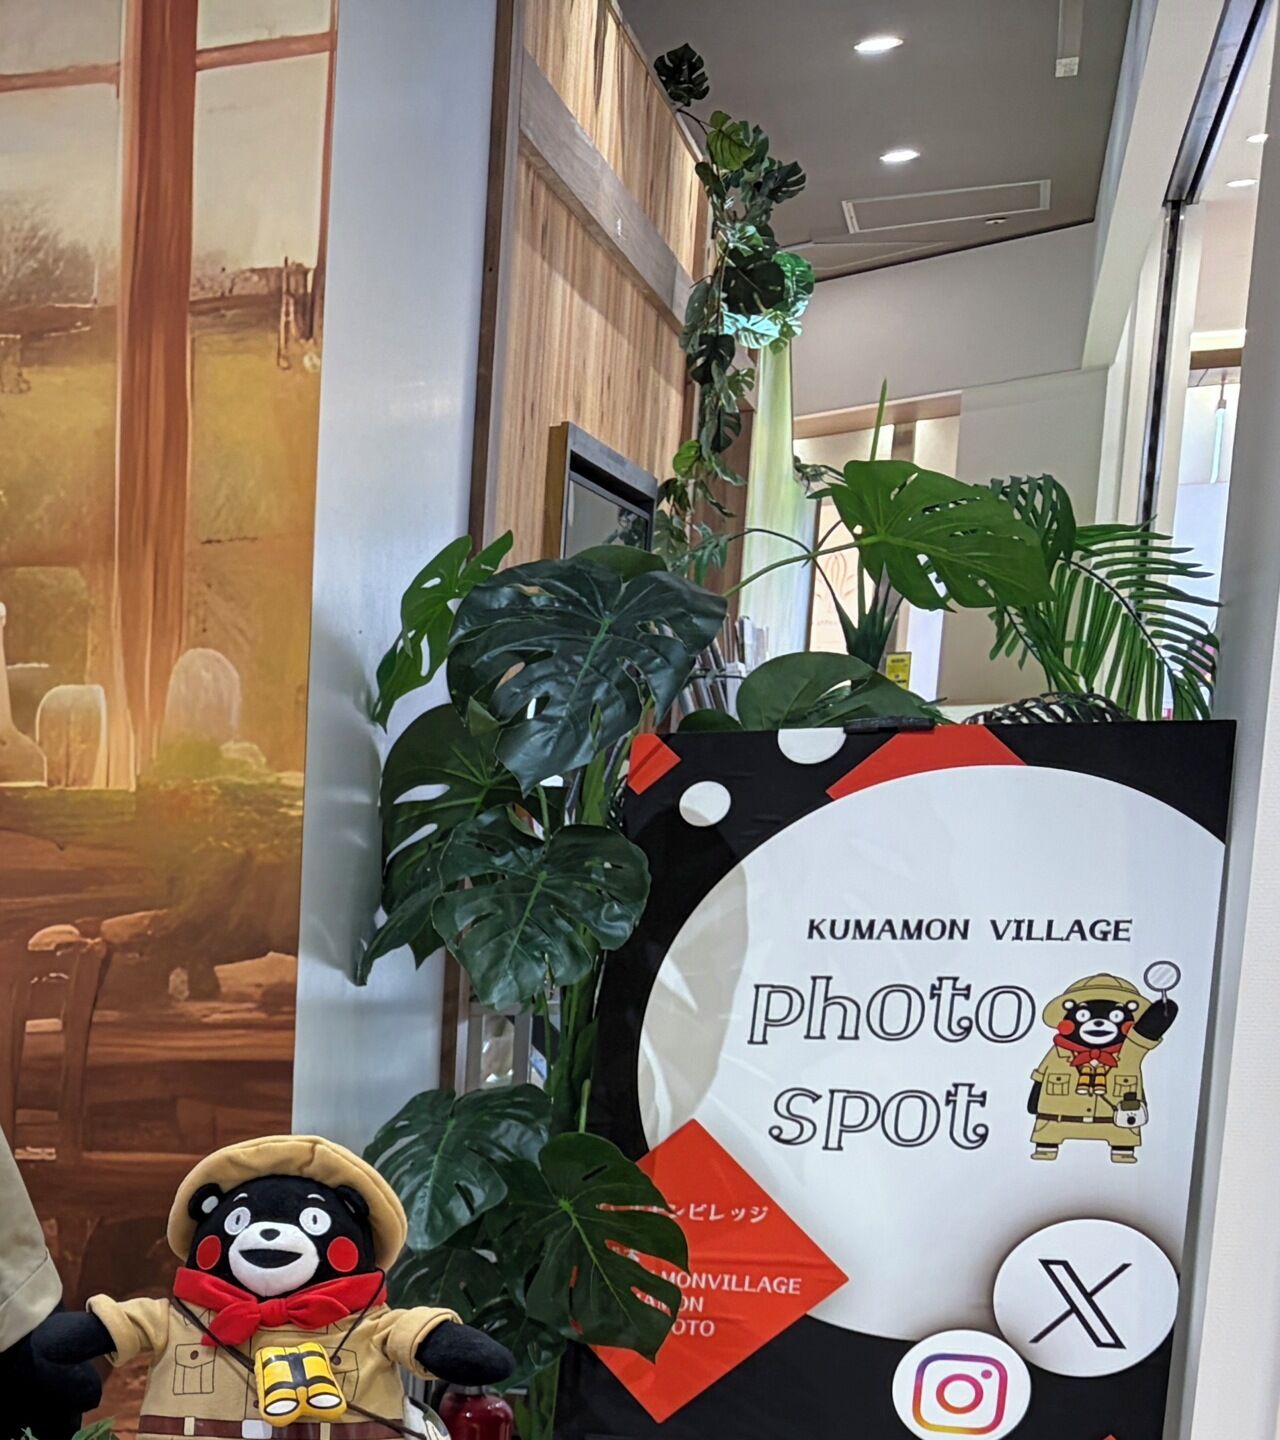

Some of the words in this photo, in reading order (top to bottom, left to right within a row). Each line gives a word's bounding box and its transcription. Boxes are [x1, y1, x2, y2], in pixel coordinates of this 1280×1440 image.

[807, 918, 970, 941] KUMAMON
[990, 918, 1133, 942] VILLAGE
[747, 975, 1036, 1045] photo
[768, 1082, 989, 1151] spot
[658, 1270, 803, 1295] MONVILLAGE
